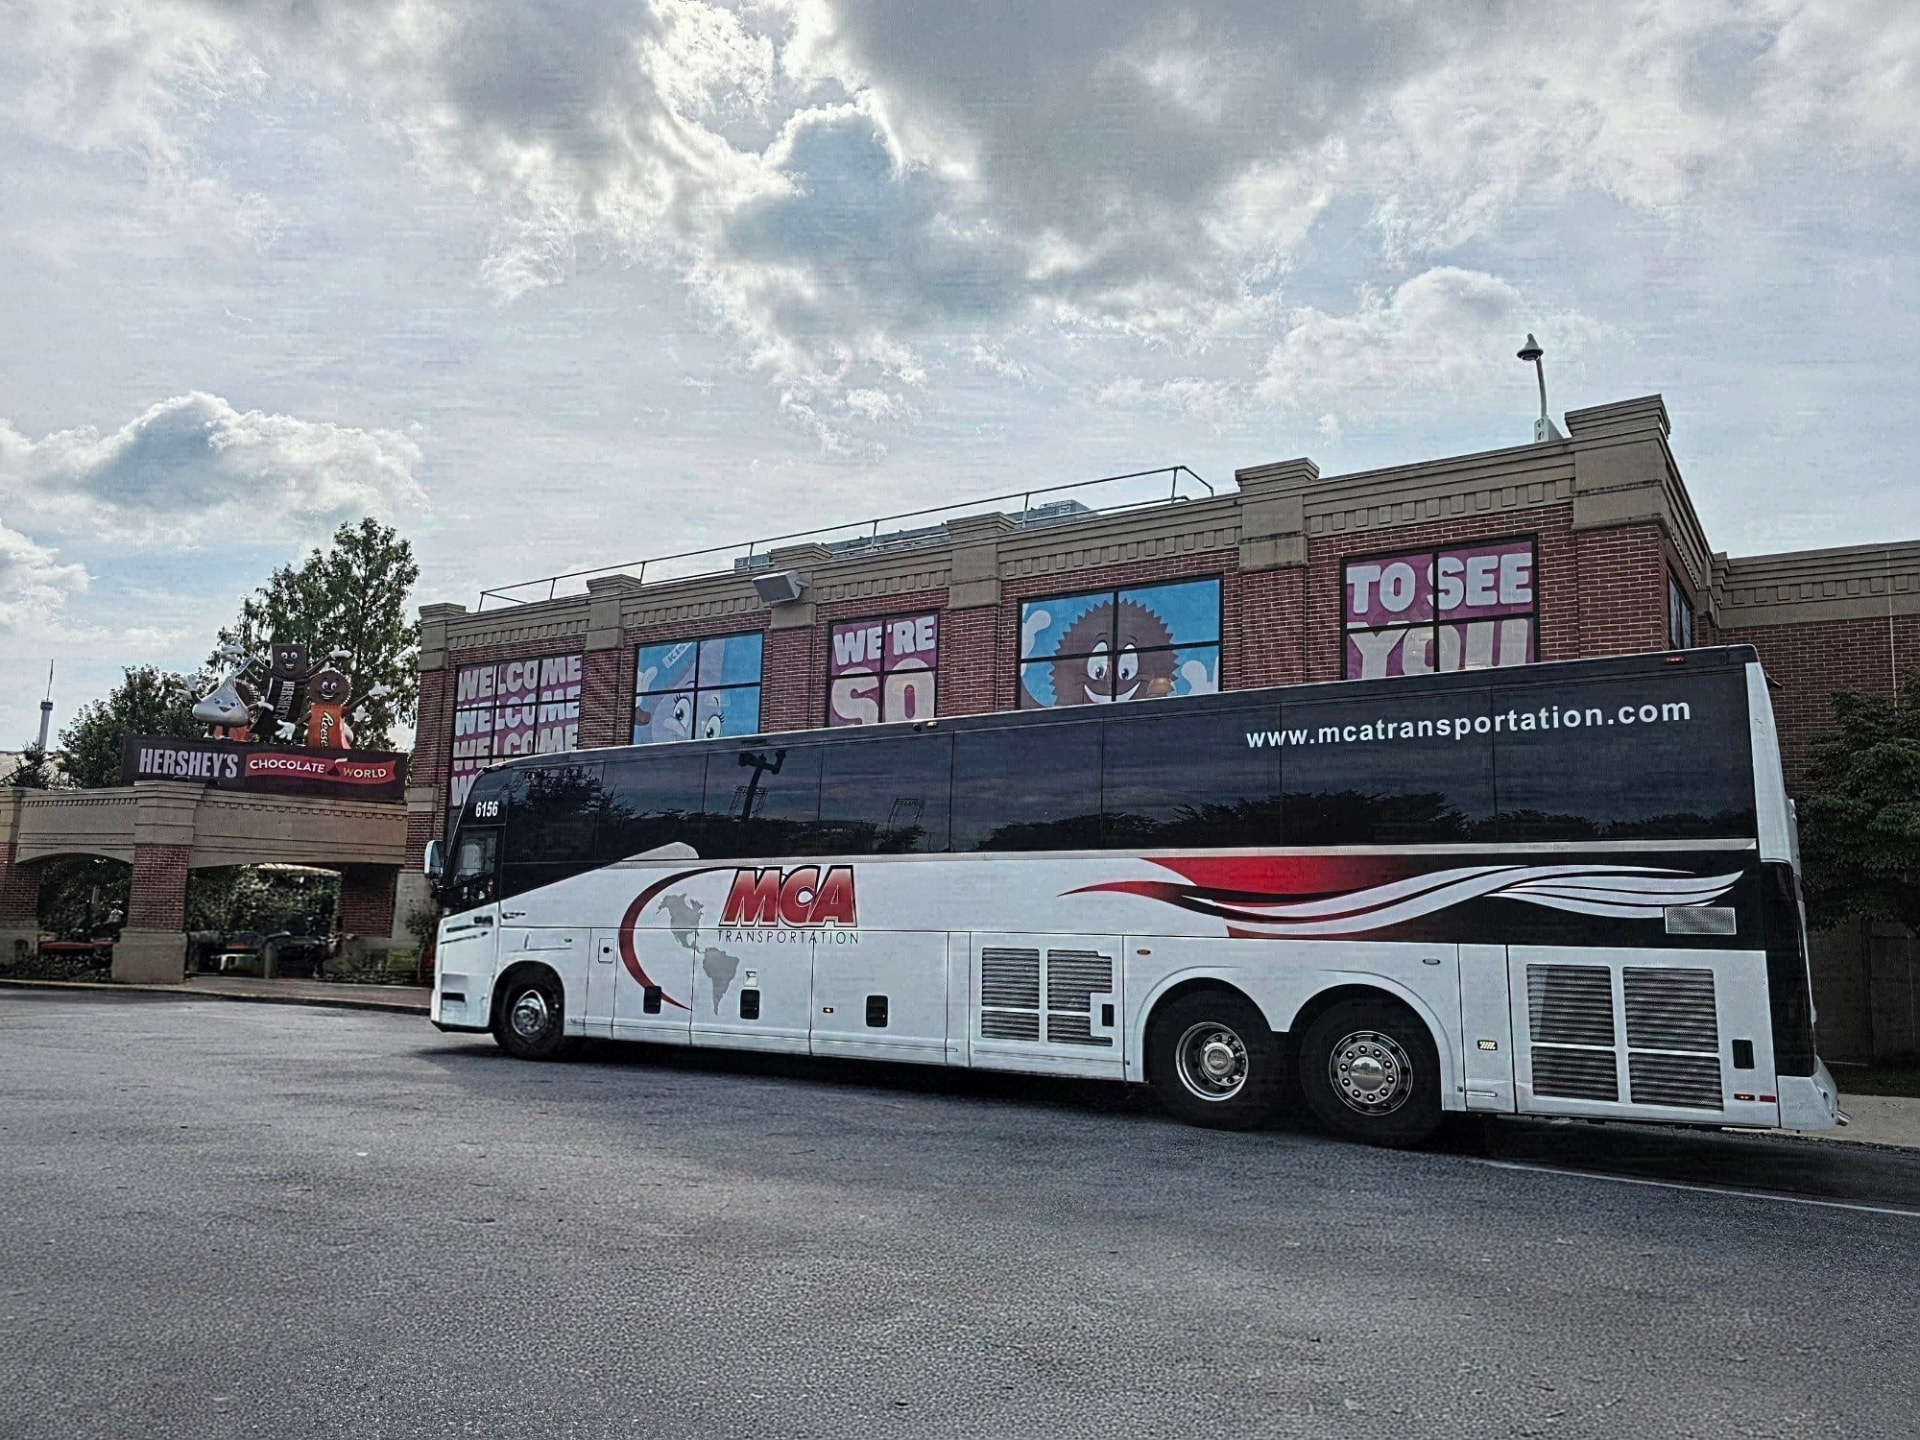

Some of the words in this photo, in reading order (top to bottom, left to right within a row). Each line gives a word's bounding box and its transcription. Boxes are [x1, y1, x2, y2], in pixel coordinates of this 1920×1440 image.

[1346, 562, 1416, 614] TO
[1426, 552, 1533, 611] SEE
[833, 615, 936, 666] WE'RE
[1346, 618, 1528, 680] YOU
[457, 655, 583, 702] WELCOME
[831, 657, 936, 725] SO
[455, 685, 581, 736] WELCOME
[1246, 702, 1691, 749] www.mcatransportation.com
[138, 749, 239, 779] HERSHEY'S
[249, 759, 326, 773] CHOCOLATE
[342, 766, 387, 779] WORLD
[453, 724, 578, 771] WELCOME
[475, 801, 499, 817] 6156
[718, 865, 858, 928] MCA
[718, 930, 859, 945] TRANSPORTATION
